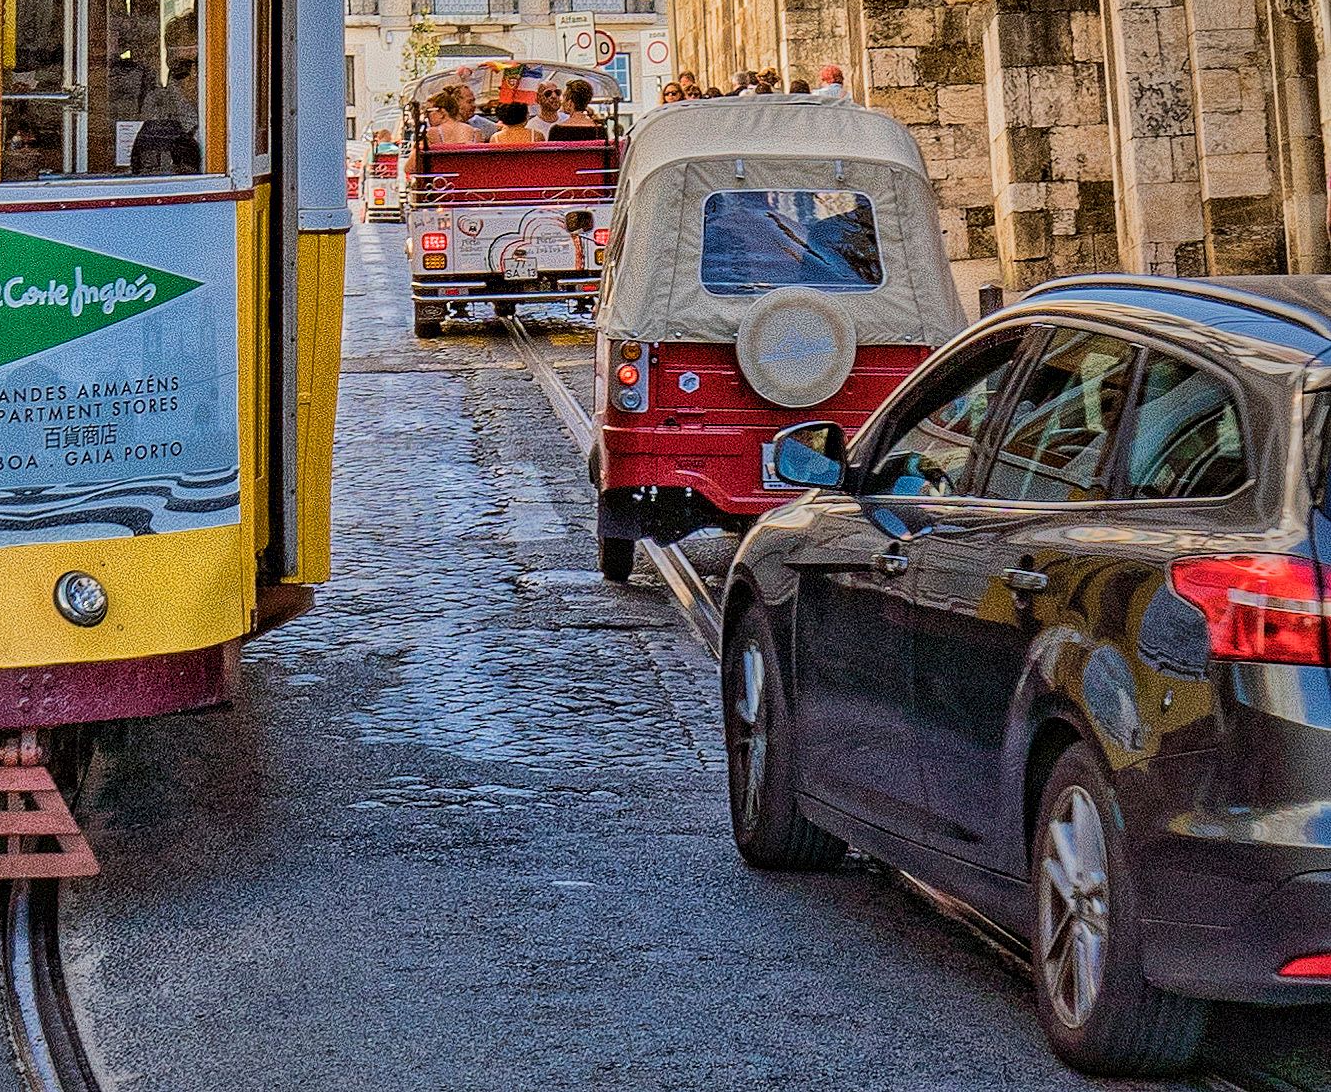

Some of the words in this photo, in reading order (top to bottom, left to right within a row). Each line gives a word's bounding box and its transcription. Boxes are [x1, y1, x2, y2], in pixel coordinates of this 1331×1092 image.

[560, 15, 588, 24] Alfama
[0, 277, 69, 308] Corte
[67, 267, 158, 317] Inglés
[77, 375, 180, 399] ARMAZÉNS
[112, 397, 179, 417] STORES
[44, 423, 118, 450] 百貨商店
[65, 448, 115, 467] GAIA
[124, 442, 184, 460] PORTO
